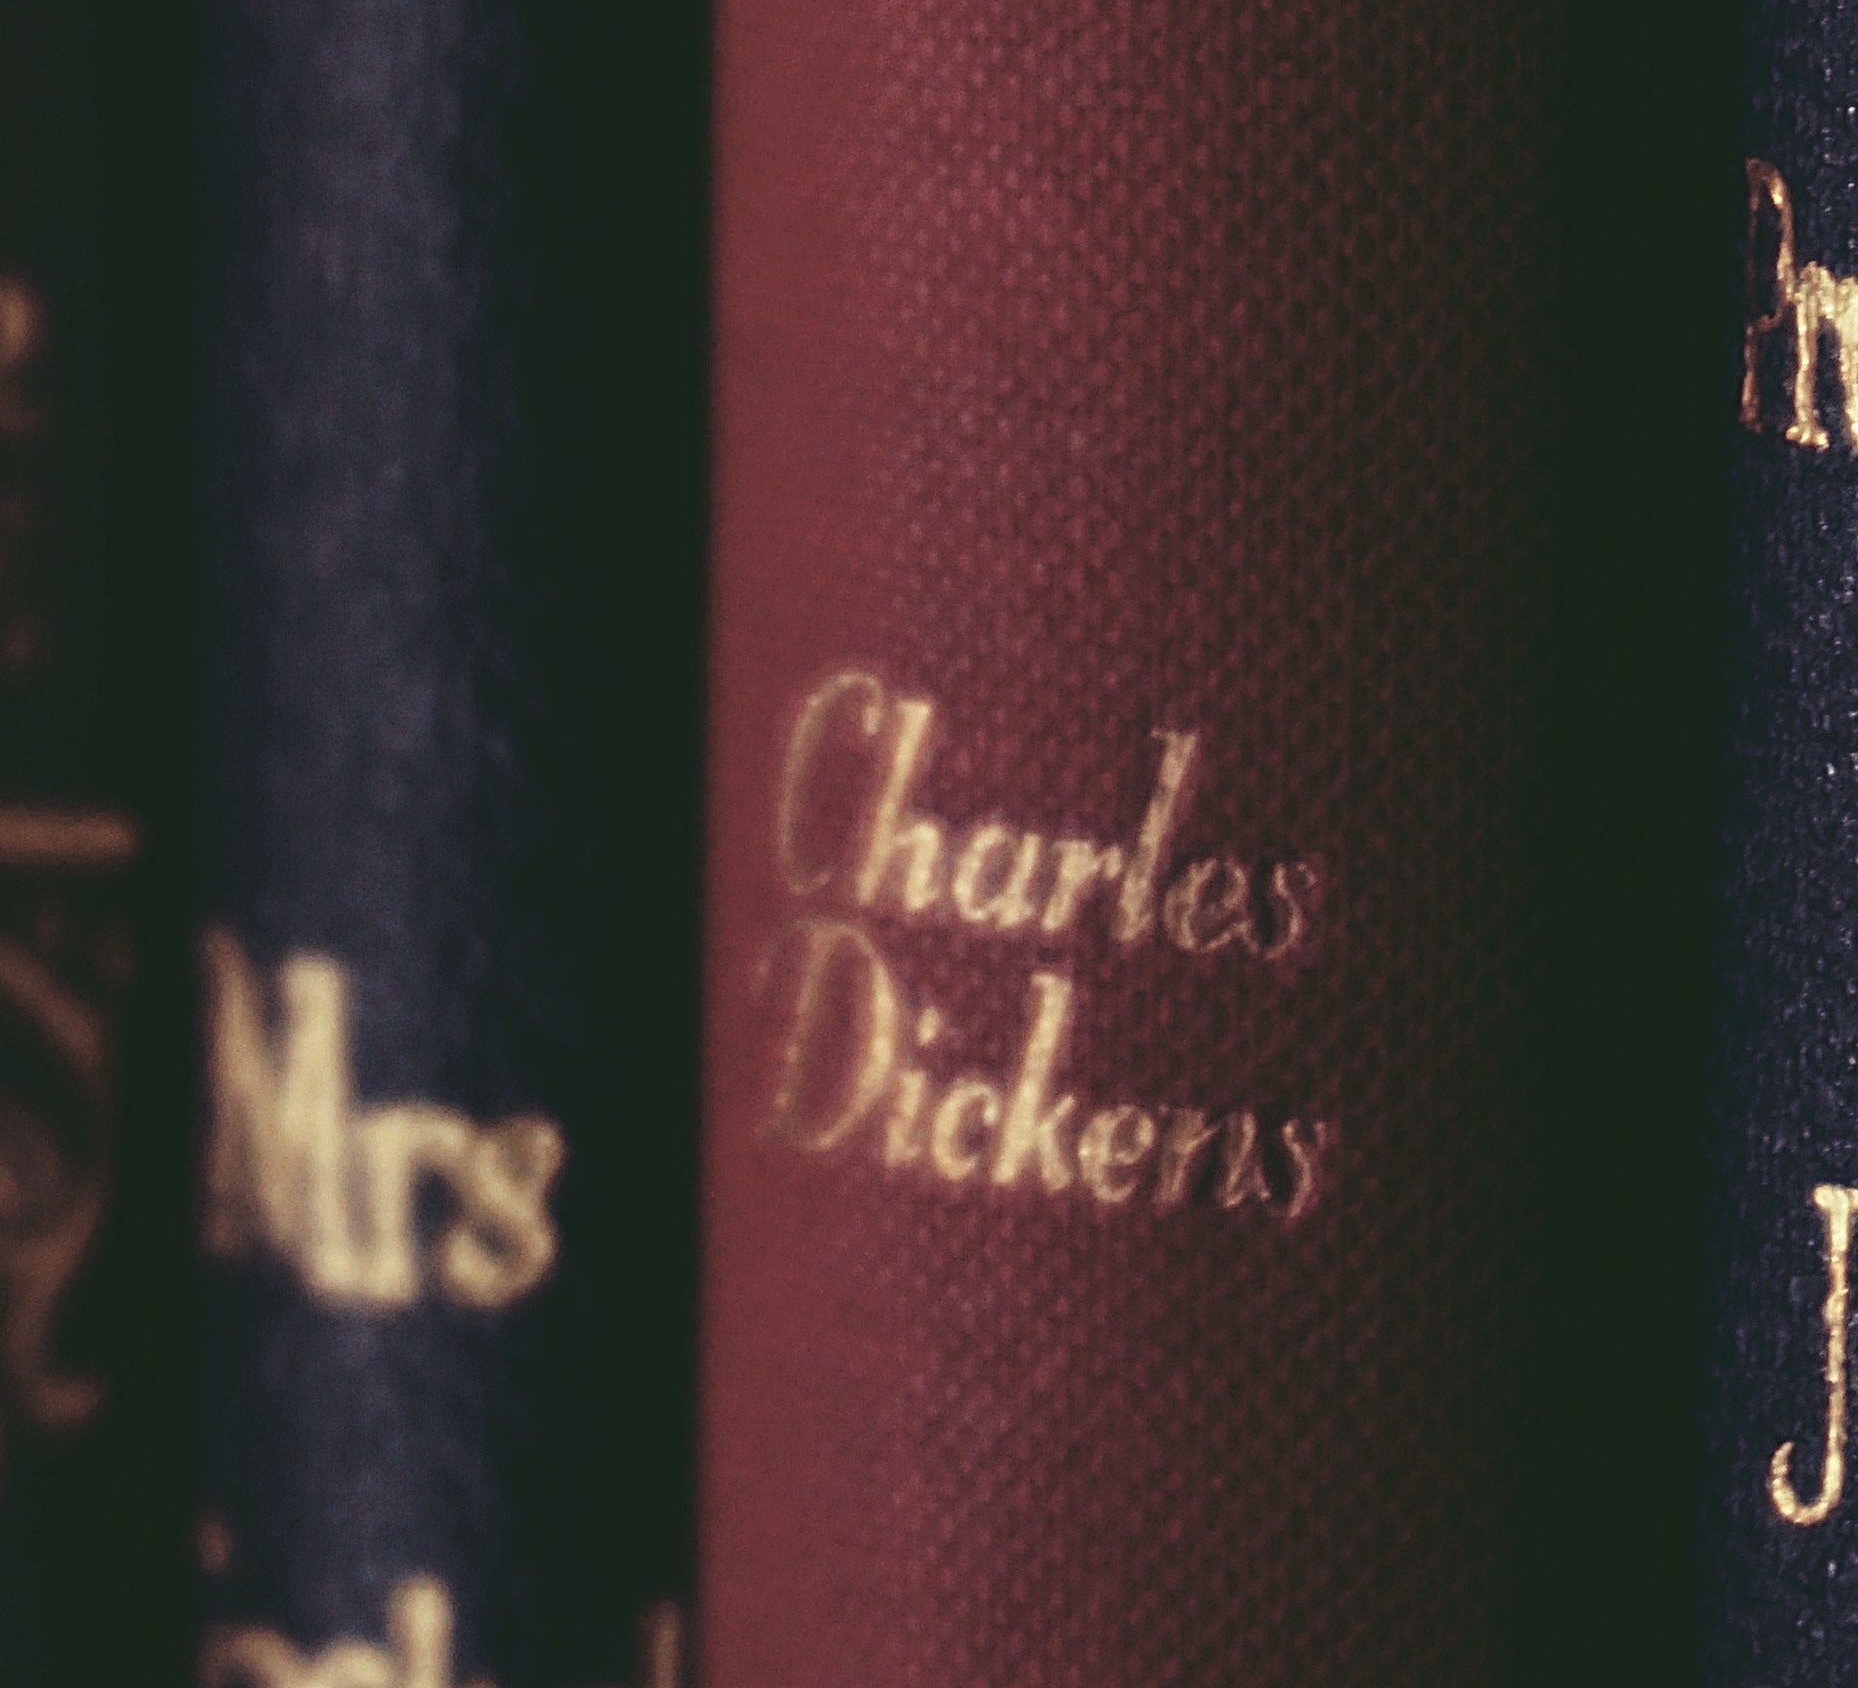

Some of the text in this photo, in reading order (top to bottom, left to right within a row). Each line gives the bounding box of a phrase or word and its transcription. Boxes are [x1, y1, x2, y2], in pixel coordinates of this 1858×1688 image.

[777, 670, 1318, 960] Charles
[196, 922, 570, 1310] Mrs
[762, 914, 1326, 1220] Dickens
